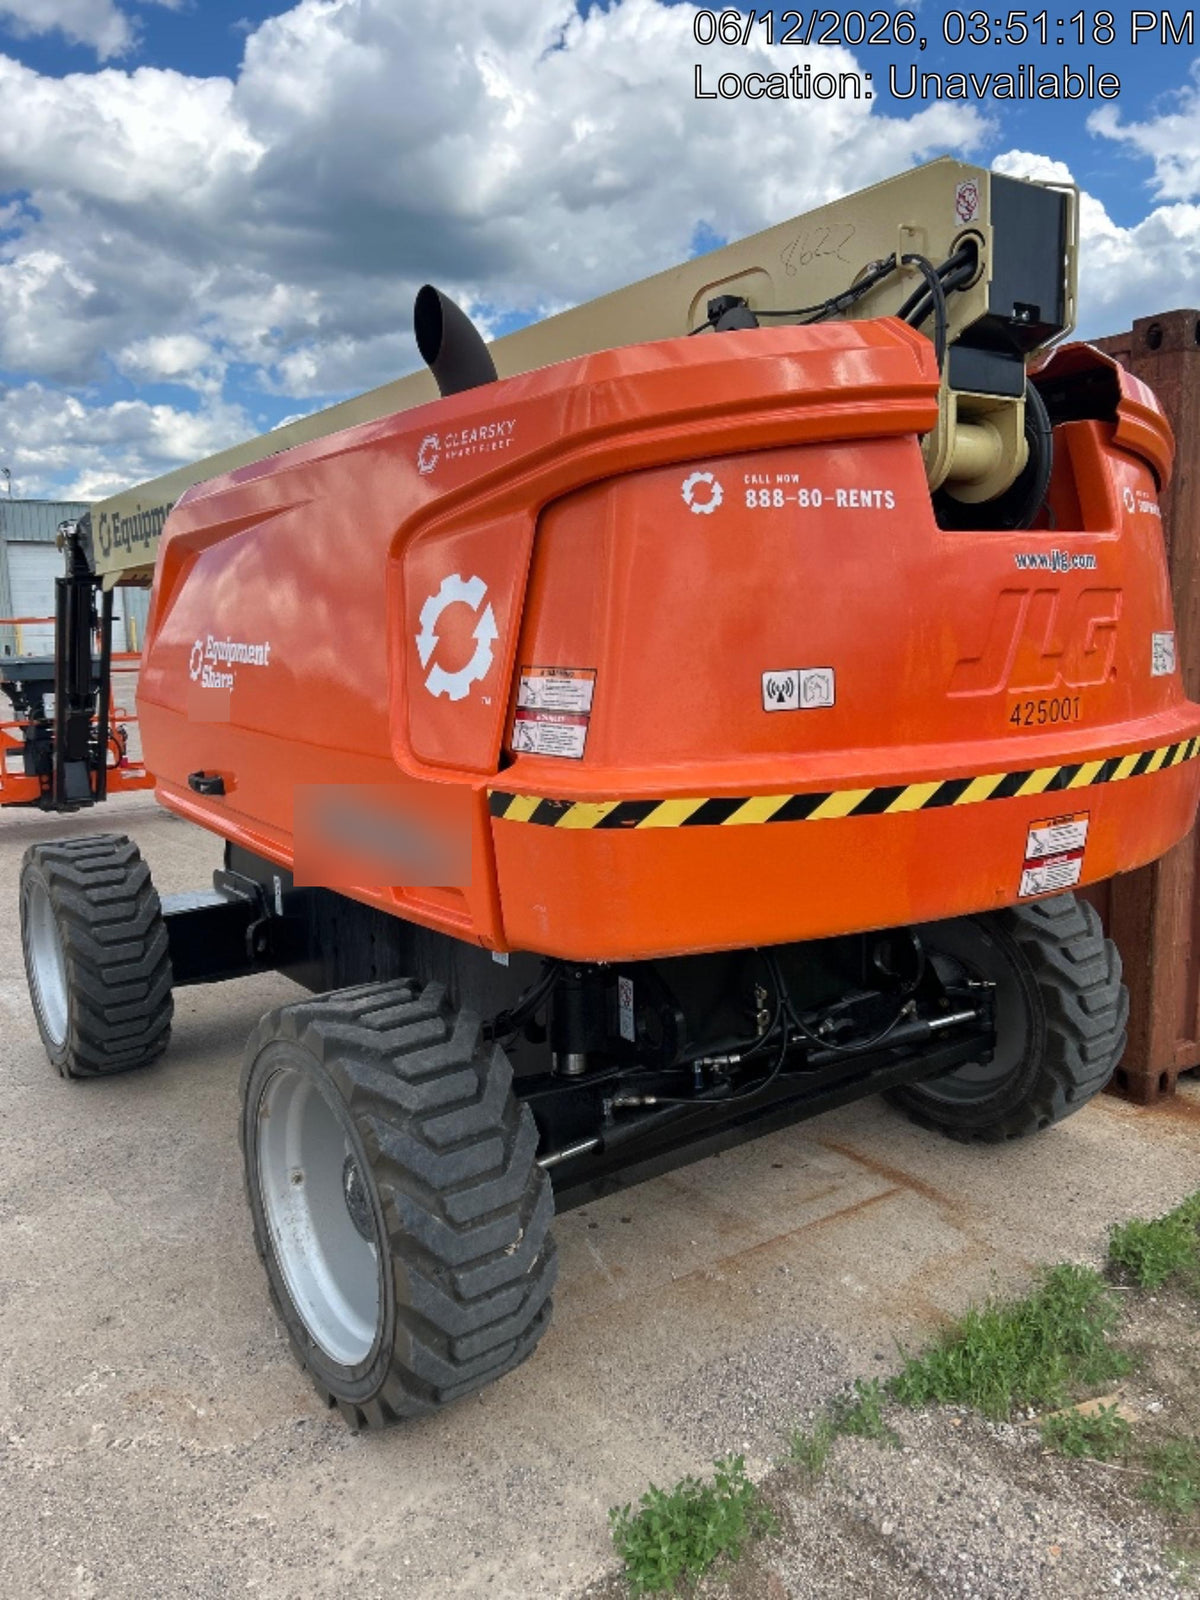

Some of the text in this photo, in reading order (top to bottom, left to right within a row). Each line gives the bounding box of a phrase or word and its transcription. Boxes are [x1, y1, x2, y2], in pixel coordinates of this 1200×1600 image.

[444, 419, 516, 449] CLEARSKY
[744, 474, 800, 484] CALL NOW
[745, 488, 895, 509] 888-80-RENTS
[1015, 549, 1097, 572] www.jlg.com
[204, 635, 270, 667] Equipment
